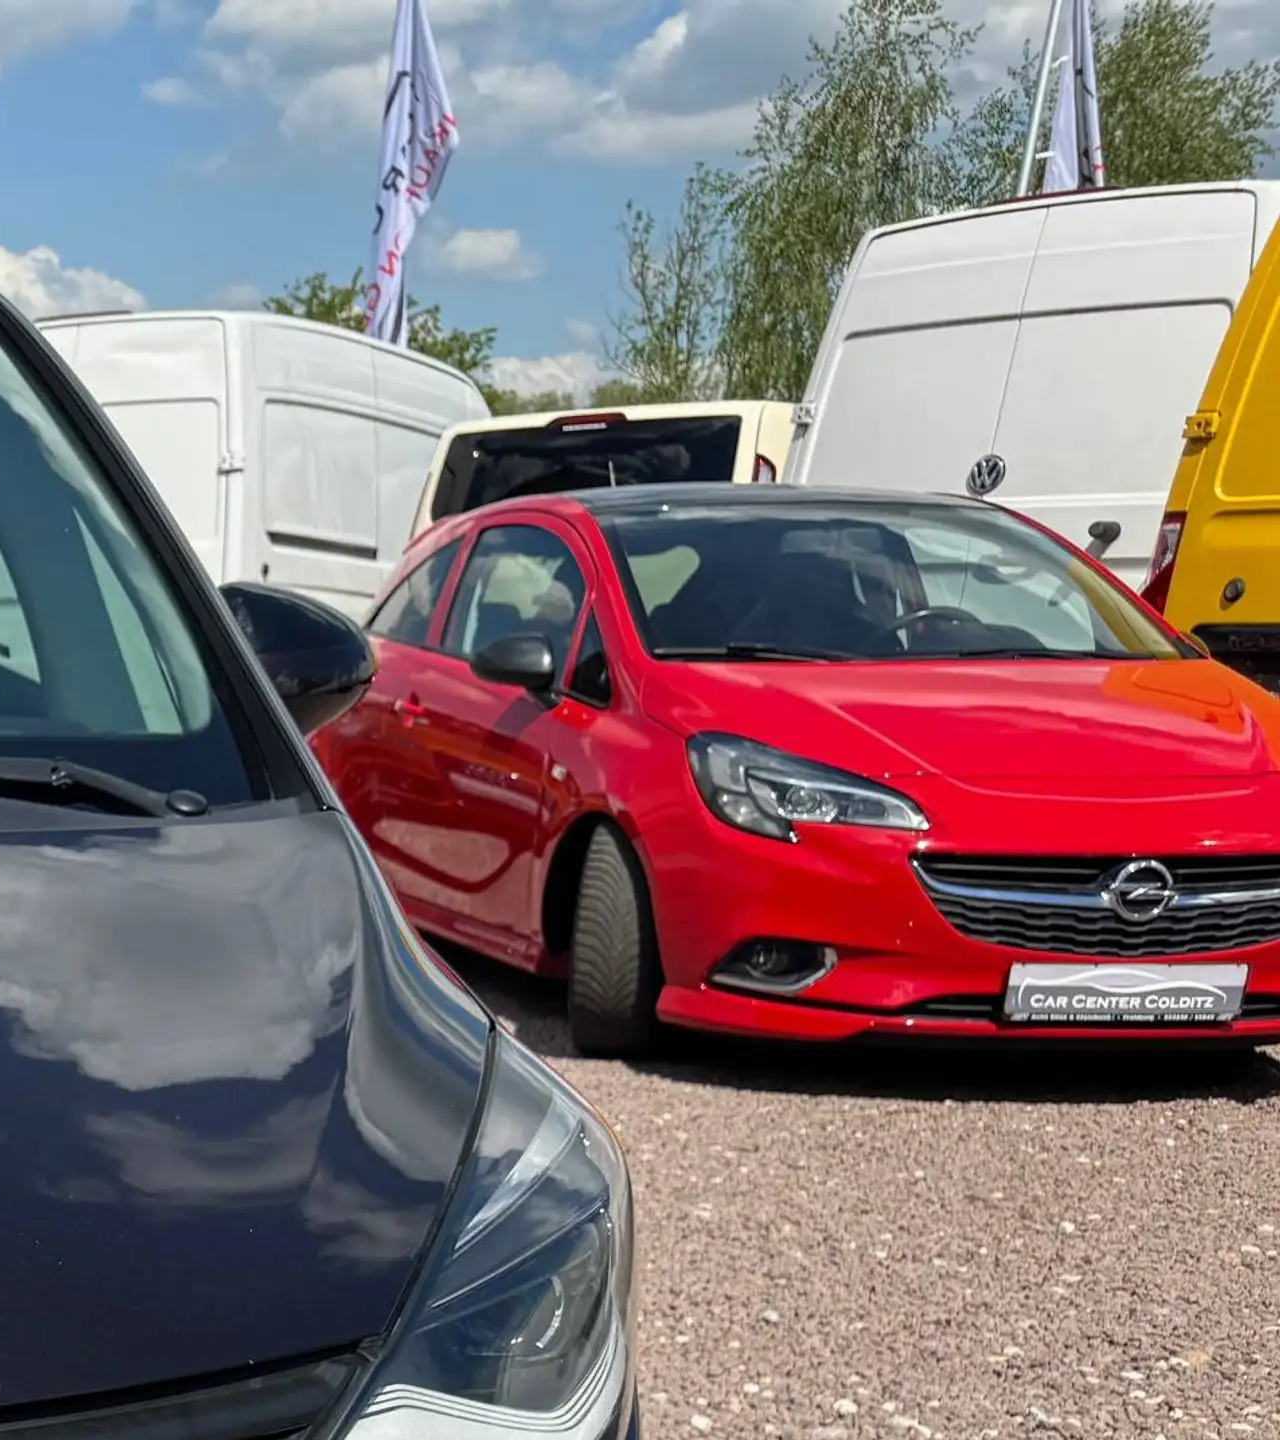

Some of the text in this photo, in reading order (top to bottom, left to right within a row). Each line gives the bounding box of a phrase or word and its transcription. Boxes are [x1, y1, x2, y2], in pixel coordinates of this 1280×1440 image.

[1030, 993, 1215, 1010] CAR CENTER COLDITZ
